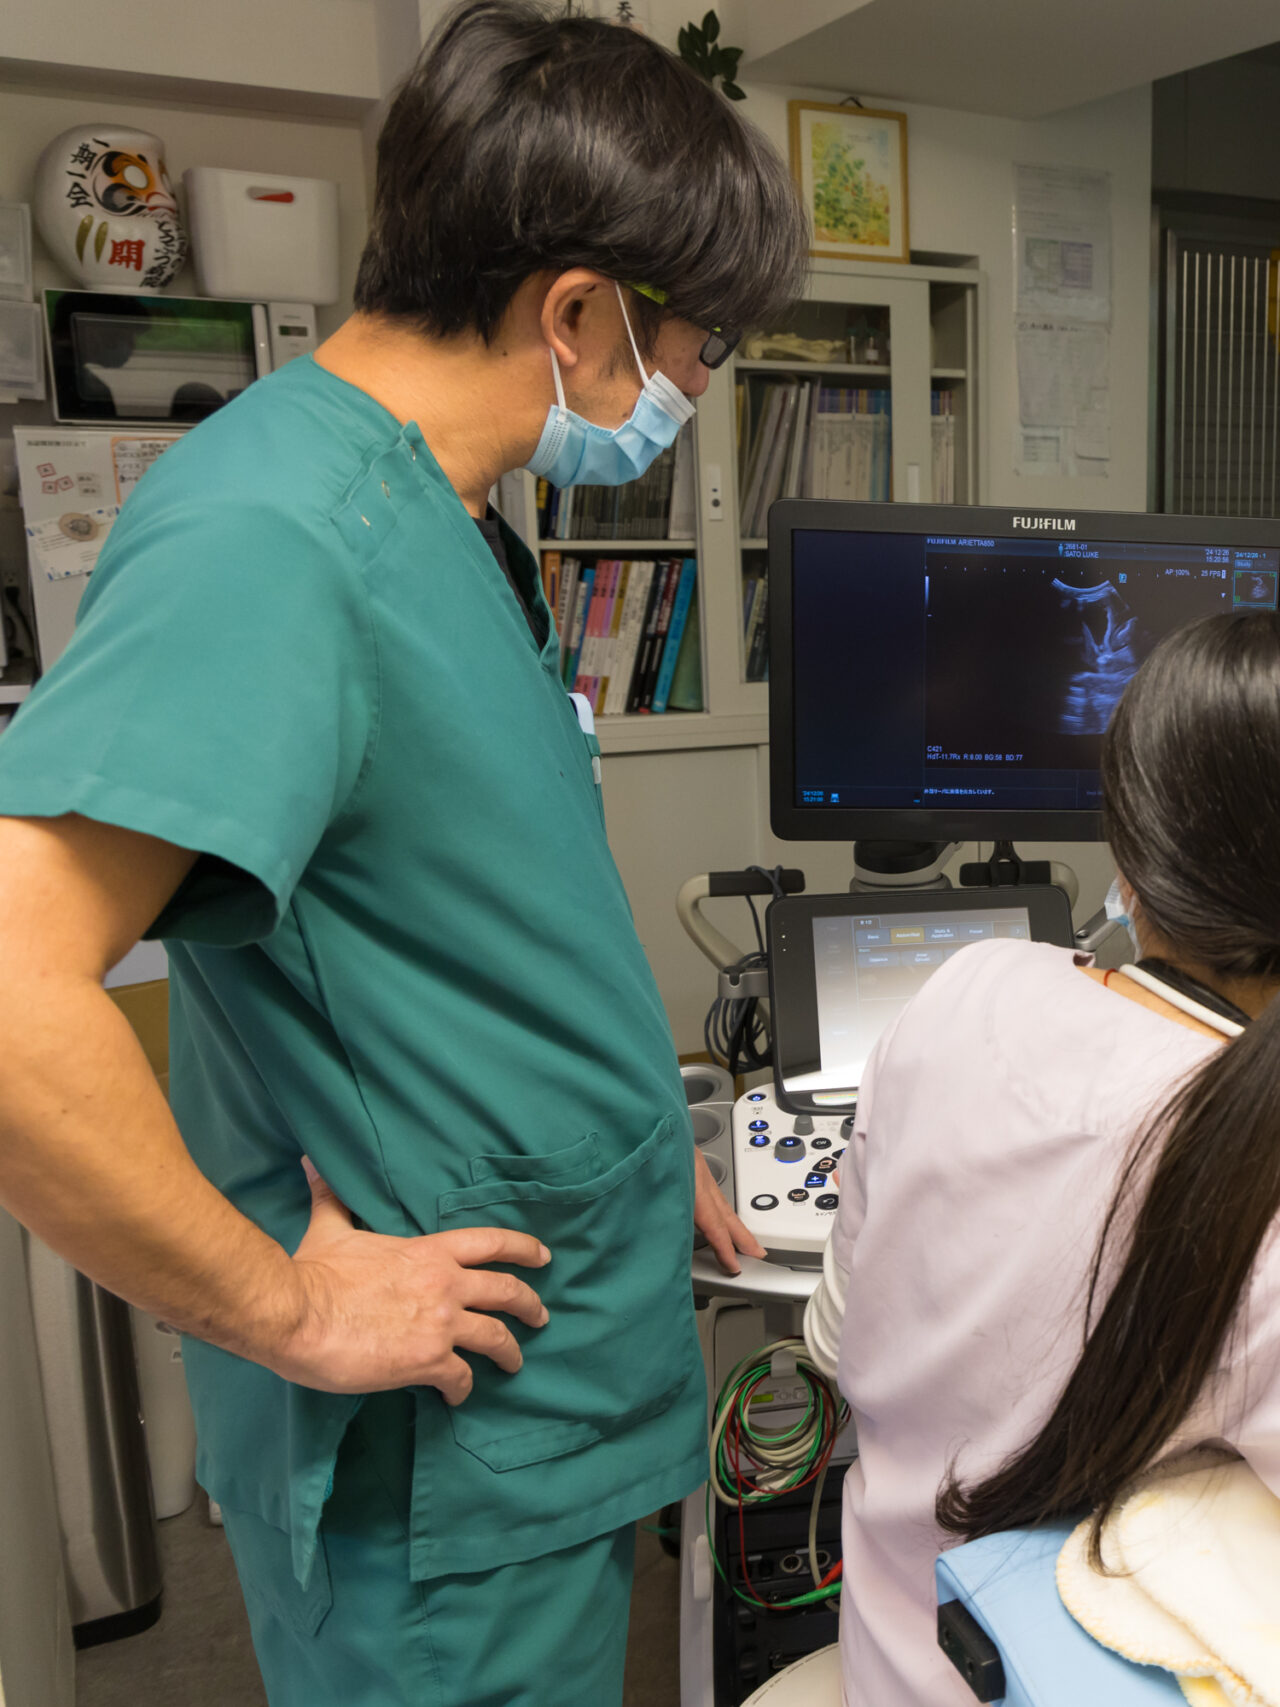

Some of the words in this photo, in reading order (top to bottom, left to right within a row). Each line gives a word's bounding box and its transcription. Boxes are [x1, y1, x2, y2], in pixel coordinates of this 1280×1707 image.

[66, 137, 110, 208] 一期一会
[1012, 516, 1076, 531] FUJIFILM
